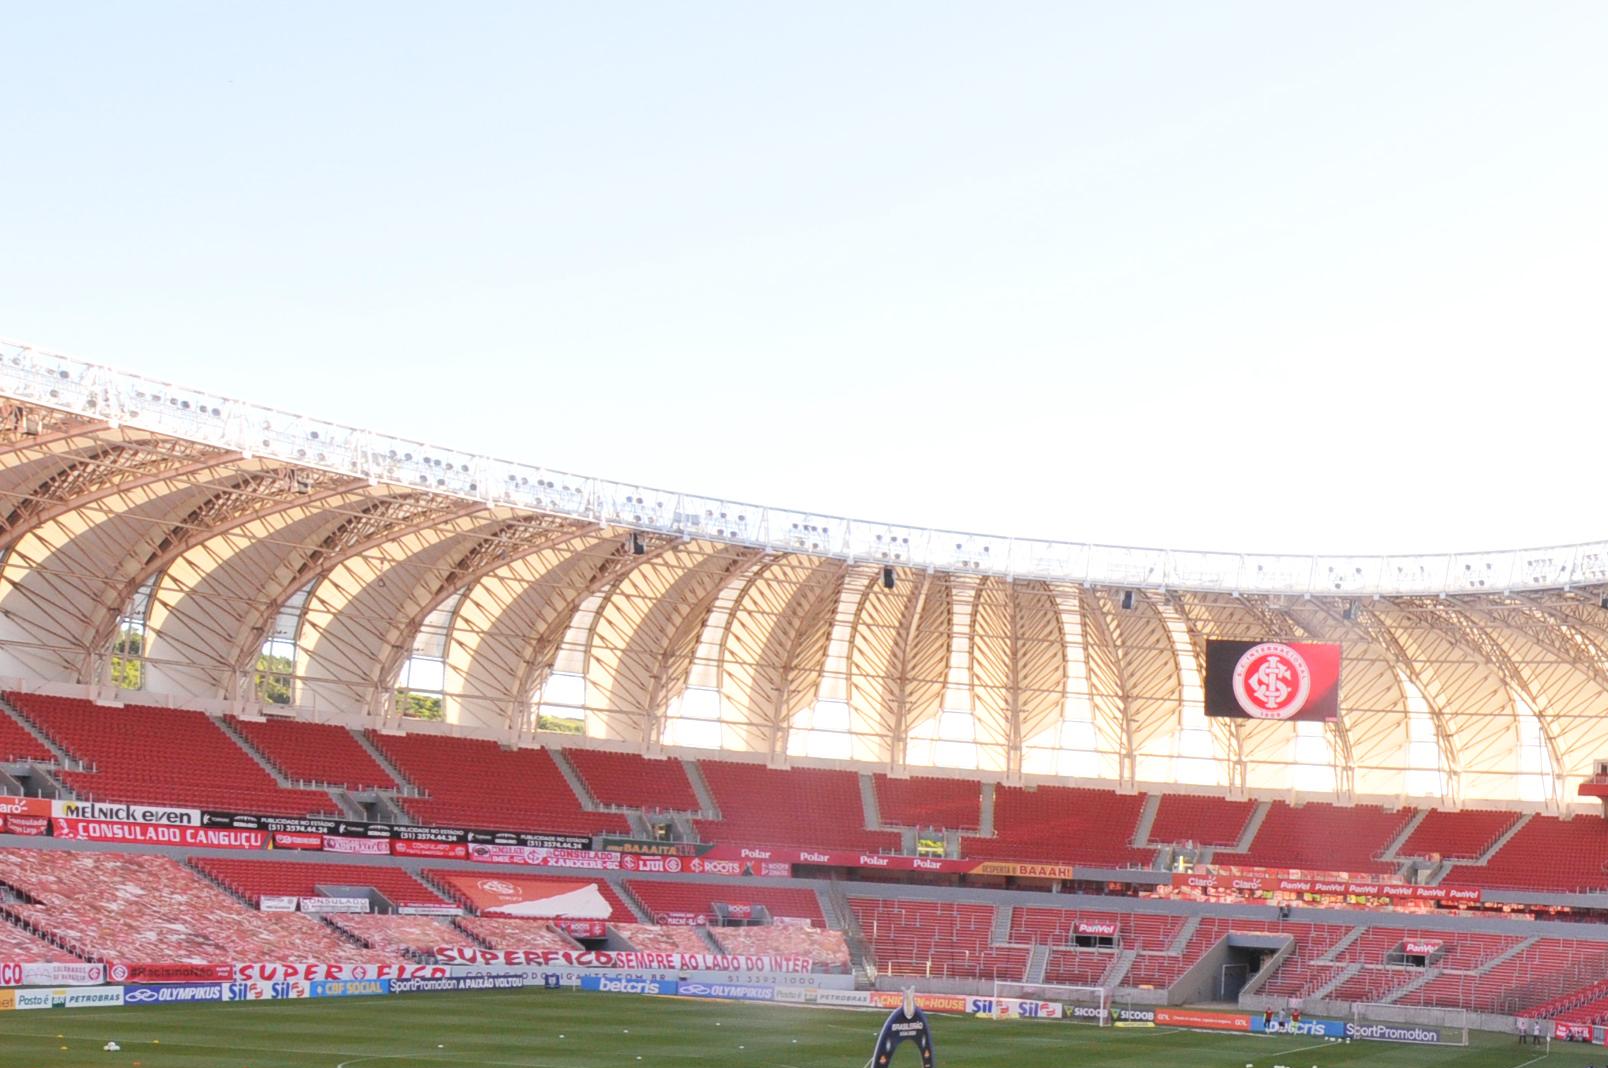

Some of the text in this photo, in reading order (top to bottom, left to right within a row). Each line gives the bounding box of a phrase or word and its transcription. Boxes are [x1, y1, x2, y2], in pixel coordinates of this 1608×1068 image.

[142, 810, 192, 824] even
[261, 817, 299, 826] PUBLICIDADE
[78, 822, 261, 849] CONSULADO CANGUÇU
[393, 825, 430, 834] PUBLICIDADE
[520, 833, 555, 841] PUBLICIDADE
[553, 848, 613, 860] CONSULADO
[741, 848, 772, 860] Polar
[800, 851, 830, 863] Polar
[860, 855, 889, 867] Polar
[913, 858, 942, 870] Polar
[705, 862, 740, 874] ROOTS
[1188, 876, 1214, 887] Claro
[1232, 878, 1258, 890] Claro
[616, 951, 810, 973] SEMPRE AO LADO DO INTER
[238, 964, 344, 981] SUPER
[271, 982, 290, 998] Sil
[346, 982, 382, 994] SOCIAL
[390, 977, 458, 993] SportPromotion
[466, 977, 494, 989] PAIXÃO
[494, 977, 523, 987] VOLTOU
[600, 978, 660, 994] betcris
[158, 986, 220, 1001] OLYMPIKUS
[228, 983, 248, 1000] Sil
[711, 985, 773, 999] OLYMPIKUS
[69, 994, 120, 1004] PETROBRAS
[972, 999, 993, 1013] Sil
[1018, 1001, 1039, 1016] Sil
[1120, 1010, 1154, 1021] SICOOB
[1346, 1023, 1437, 1042] SportPromotion
